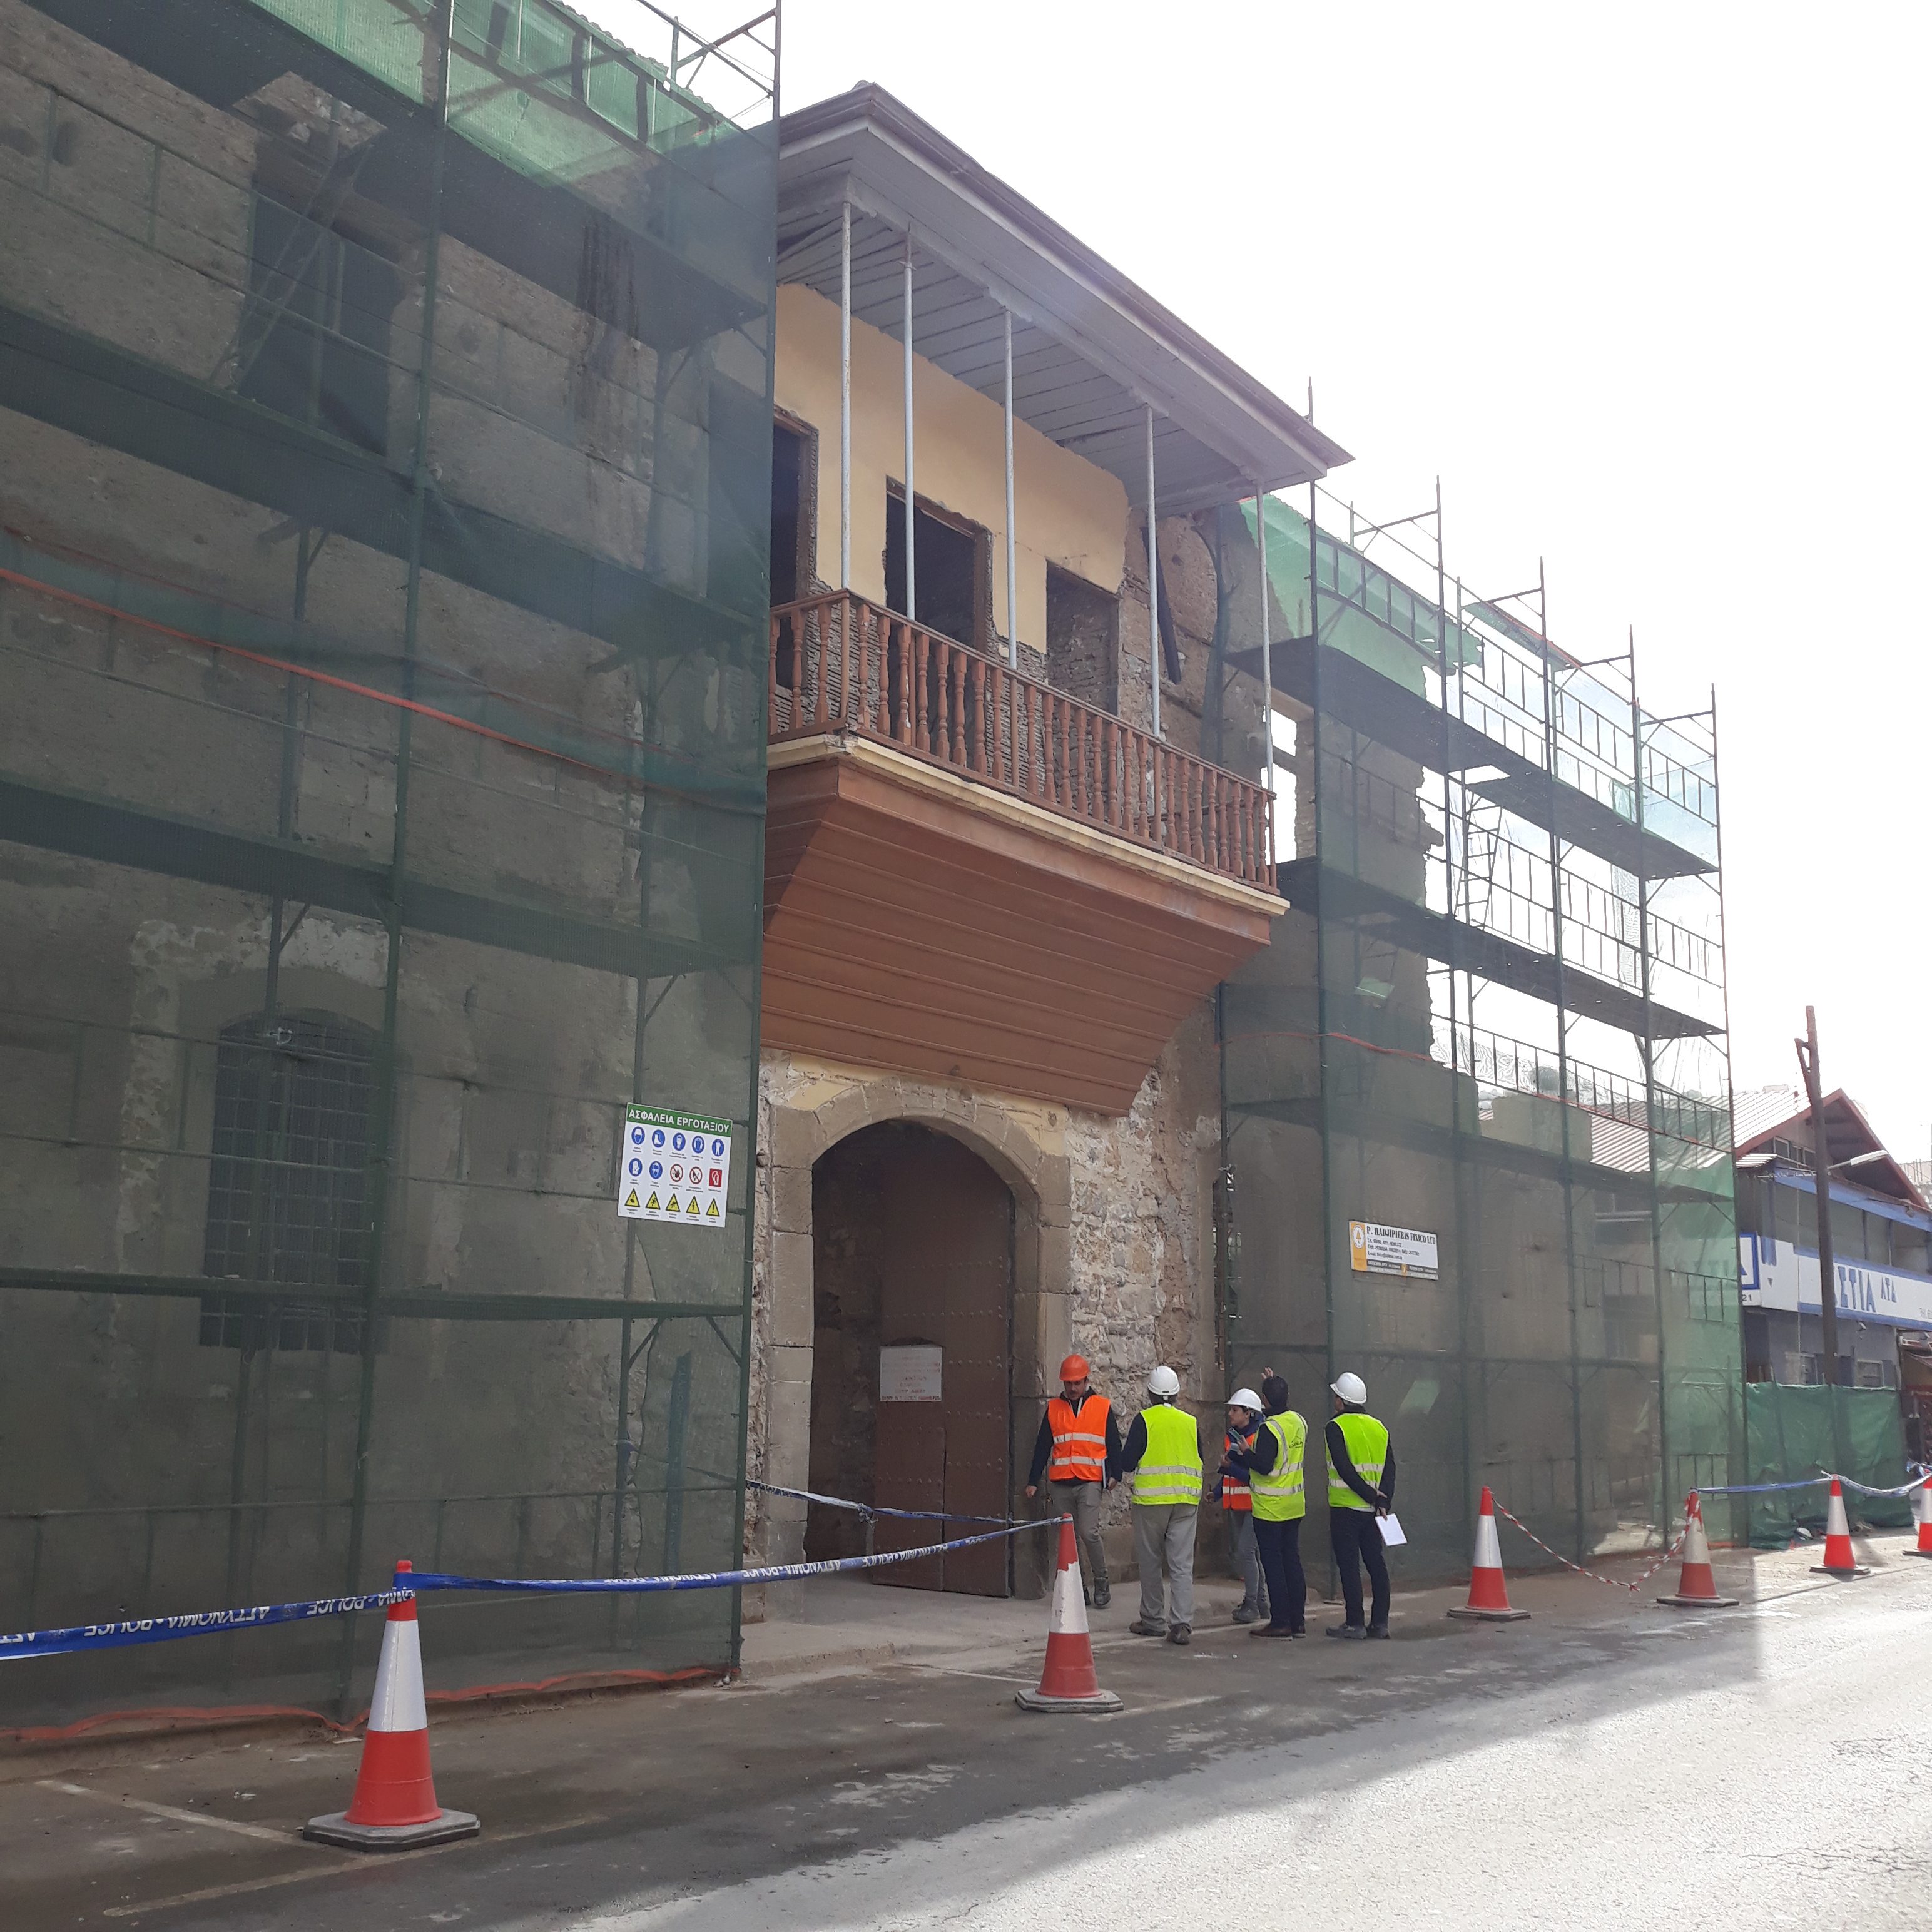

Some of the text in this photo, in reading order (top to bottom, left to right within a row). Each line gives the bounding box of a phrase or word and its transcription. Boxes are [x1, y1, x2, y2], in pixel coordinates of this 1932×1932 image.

[629, 1109, 730, 1133] ΑΣΦΑΛΕΙΑ ΕΡΓΟΤΑΞΙΟΥ
[1427, 1236, 1436, 1245] LTD
[1836, 1266, 1876, 1313] ΣΤΙΑ
[307, 1596, 368, 1615] POLICE
